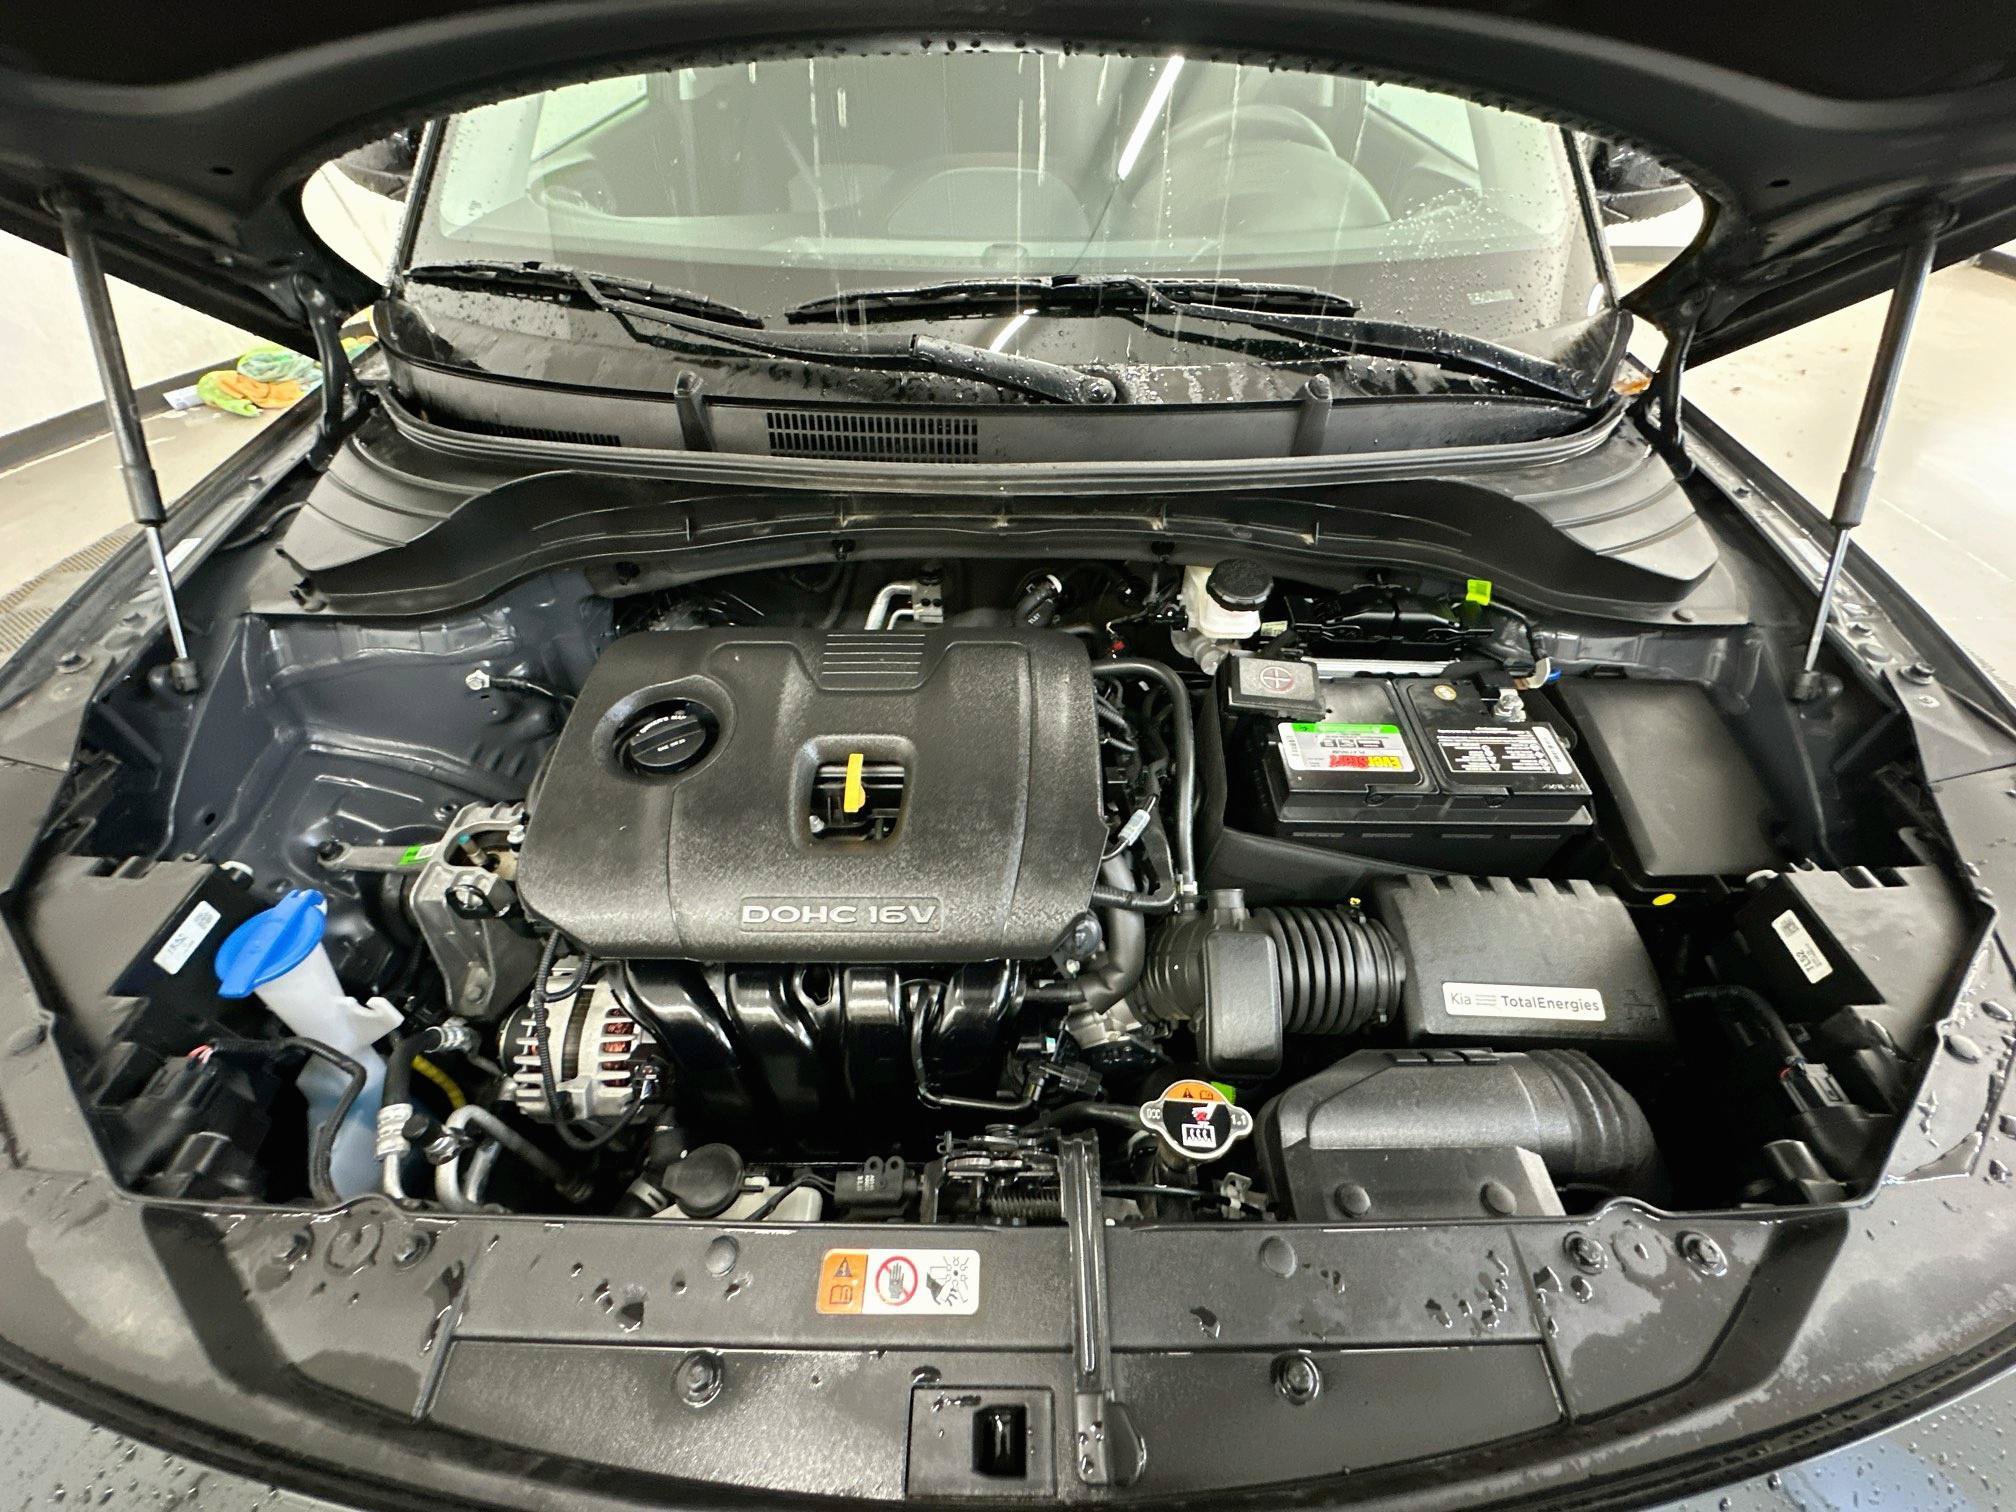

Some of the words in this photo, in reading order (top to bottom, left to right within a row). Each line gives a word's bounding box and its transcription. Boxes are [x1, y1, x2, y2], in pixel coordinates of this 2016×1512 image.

[1329, 754, 1402, 769] EverStart
[742, 905, 858, 924] DOHC
[868, 905, 937, 924] 16V
[1450, 992, 1472, 1005] Kia
[1501, 995, 1600, 1013] TotalEnergies
